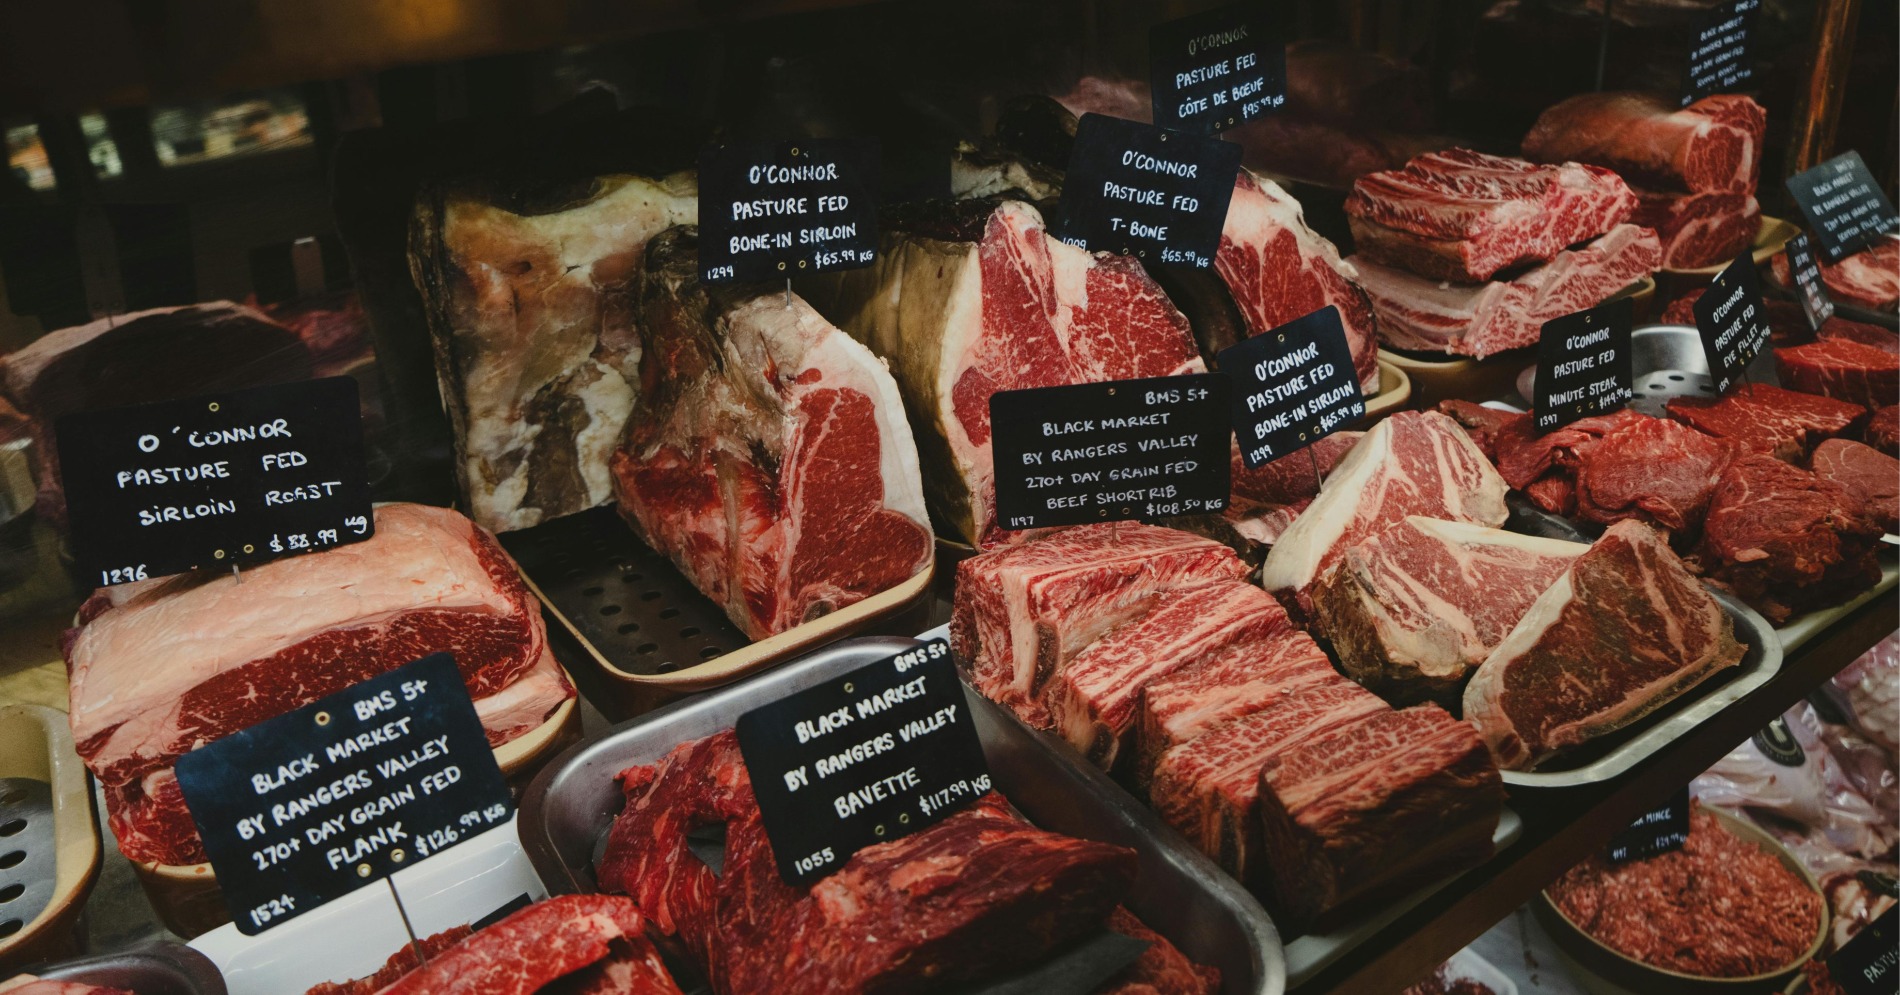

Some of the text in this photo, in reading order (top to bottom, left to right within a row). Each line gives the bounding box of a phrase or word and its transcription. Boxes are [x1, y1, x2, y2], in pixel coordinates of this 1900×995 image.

[1189, 25, 1248, 56] O'CONNOR
[1176, 53, 1257, 89] PASTURE FED
[1179, 97, 1209, 118] CÔTE
[1213, 91, 1228, 106] DE
[1273, 95, 1284, 108] KG
[750, 163, 839, 184] O'CONNOR
[1123, 151, 1198, 178] O'CONNOR
[733, 196, 849, 221] PASTURE FED
[1104, 182, 1198, 212] PASTURE FED
[730, 223, 856, 254] BONE-IN SIRLOIN
[815, 250, 874, 269] $65.99 KG
[1161, 247, 1209, 268] $65.99 KG
[708, 266, 734, 280] 1299
[1713, 286, 1745, 324] O'CONNOR
[1567, 327, 1610, 350] O'CONNOR
[1715, 304, 1755, 352] PASTURE FED
[1724, 324, 1759, 369] EYE FILLET
[1255, 342, 1319, 382] O'CONNOR
[1555, 349, 1615, 379] PASTURE FED
[1145, 388, 1209, 405] BMS 5+
[1247, 363, 1335, 413] PASTURE FED
[1549, 376, 1617, 408] MINUTE STEAK
[1042, 413, 1171, 437] BLACK MARKET
[1255, 381, 1355, 440] BONE-IN SIRLOIN
[1320, 403, 1363, 432] $65.99 KG
[1540, 414, 1558, 427] 1397
[1023, 434, 1199, 466] BY RANGERS VALLEY
[1250, 445, 1273, 464] 1299
[117, 451, 308, 488] PASTURE FED
[1026, 460, 1199, 489] 270+ DAY GRAIN FED
[266, 482, 342, 506] ROAST
[1047, 484, 1178, 510] BEEF SHORT RIB
[1146, 499, 1223, 516] $108.50 KG
[1011, 516, 1035, 527] 1197
[102, 565, 149, 586] 1296
[894, 643, 948, 673] BMS 5+
[354, 679, 428, 721] BMS 5+
[794, 676, 927, 744] BLACK MARKET
[251, 717, 412, 795] BLACK MARKET
[784, 705, 957, 793] BY RANGERS VALLEY
[236, 735, 449, 840] BY RANGERS VALLEY
[834, 767, 921, 819] BAVETTE
[919, 774, 992, 817] $117.99 KG
[252, 766, 461, 871] 270+ DAY GRAIN FED
[414, 803, 507, 857] $126.99 KG
[1646, 808, 1672, 823] MINCE
[326, 821, 408, 870] FLANK
[795, 847, 835, 875] 1055
